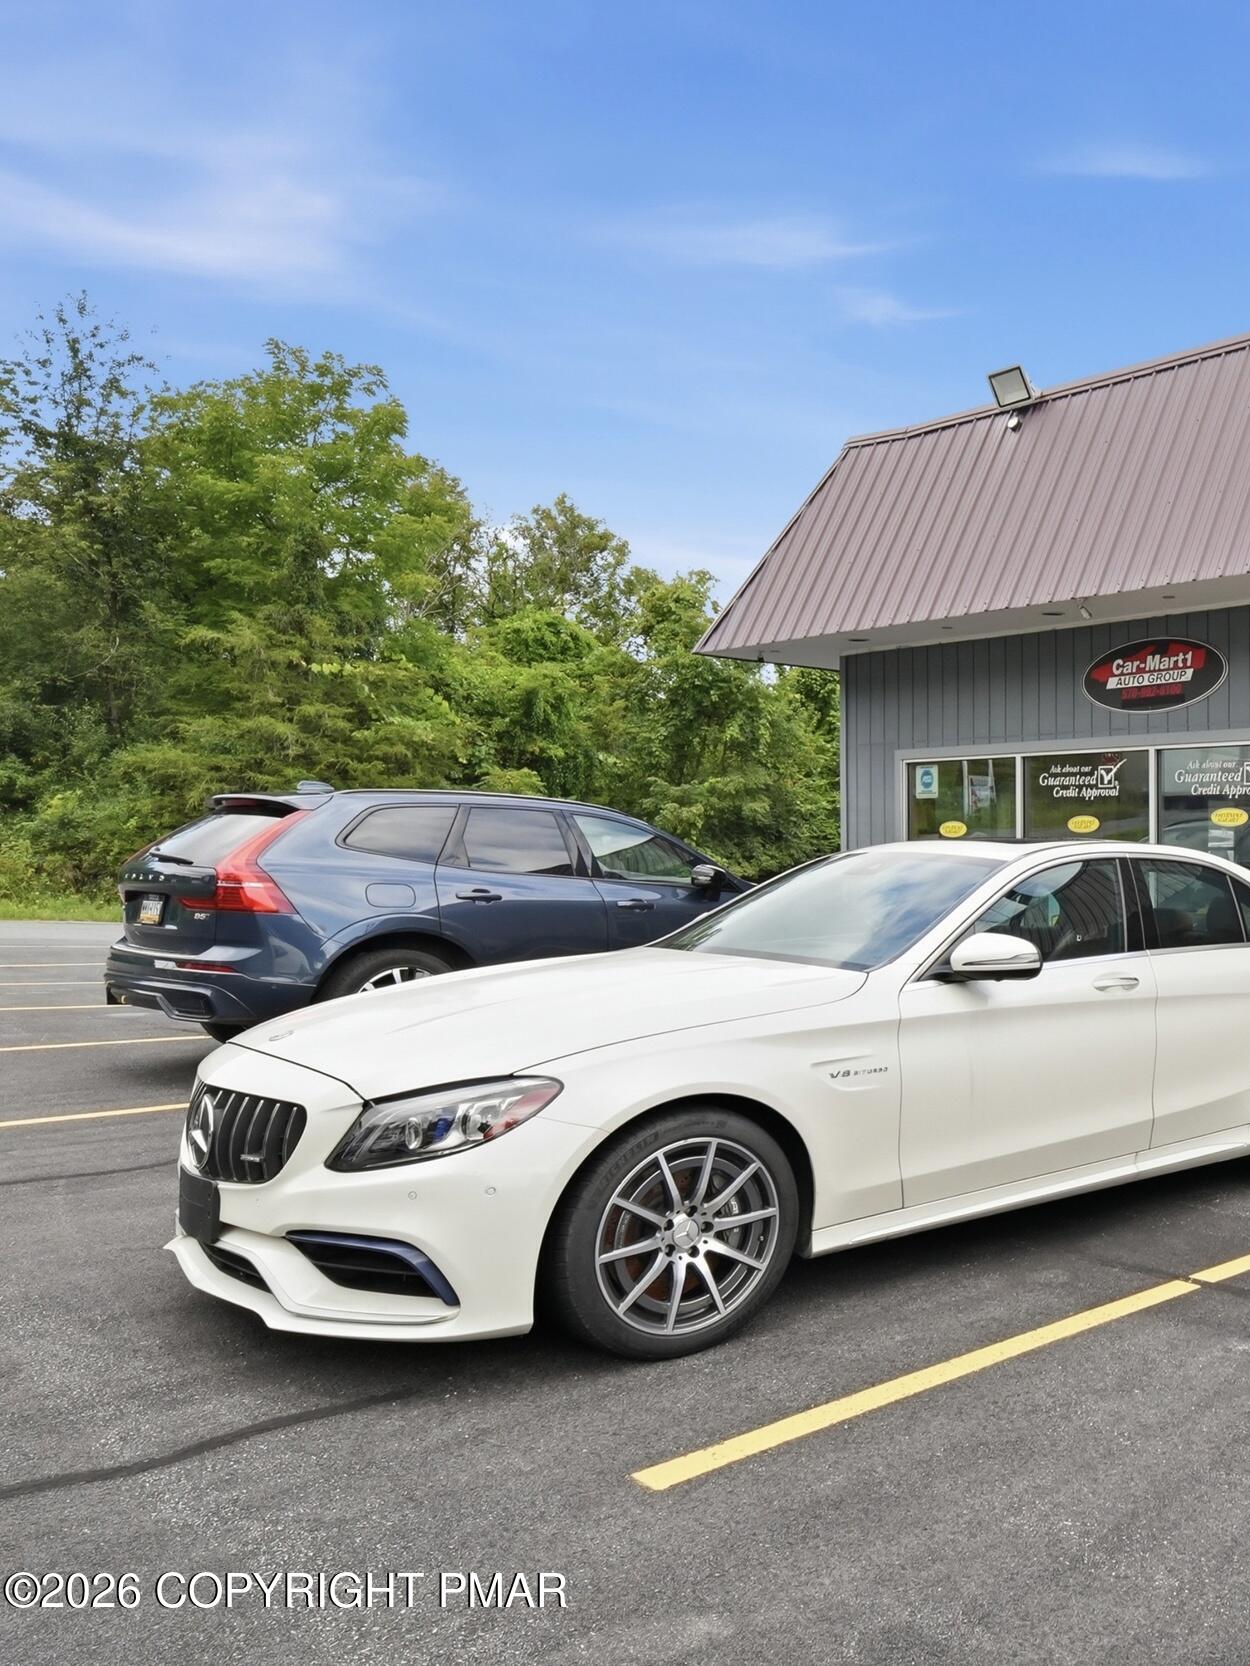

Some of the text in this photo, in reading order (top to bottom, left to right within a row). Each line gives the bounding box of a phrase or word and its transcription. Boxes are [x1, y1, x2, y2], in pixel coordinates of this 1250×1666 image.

[1112, 651, 1192, 675] Car-Mart1
[1115, 670, 1187, 687] AUTO GROUP
[1050, 765, 1061, 773] Ask
[1062, 764, 1080, 773] about
[1187, 760, 1200, 769] Ask
[1201, 760, 1222, 768] about
[1039, 770, 1097, 786] Guaranteed
[1174, 767, 1243, 783] Guaranteed
[1053, 785, 1120, 800] Credit Approval
[1191, 783, 1220, 796] Credit
[829, 1069, 851, 1079] V8
